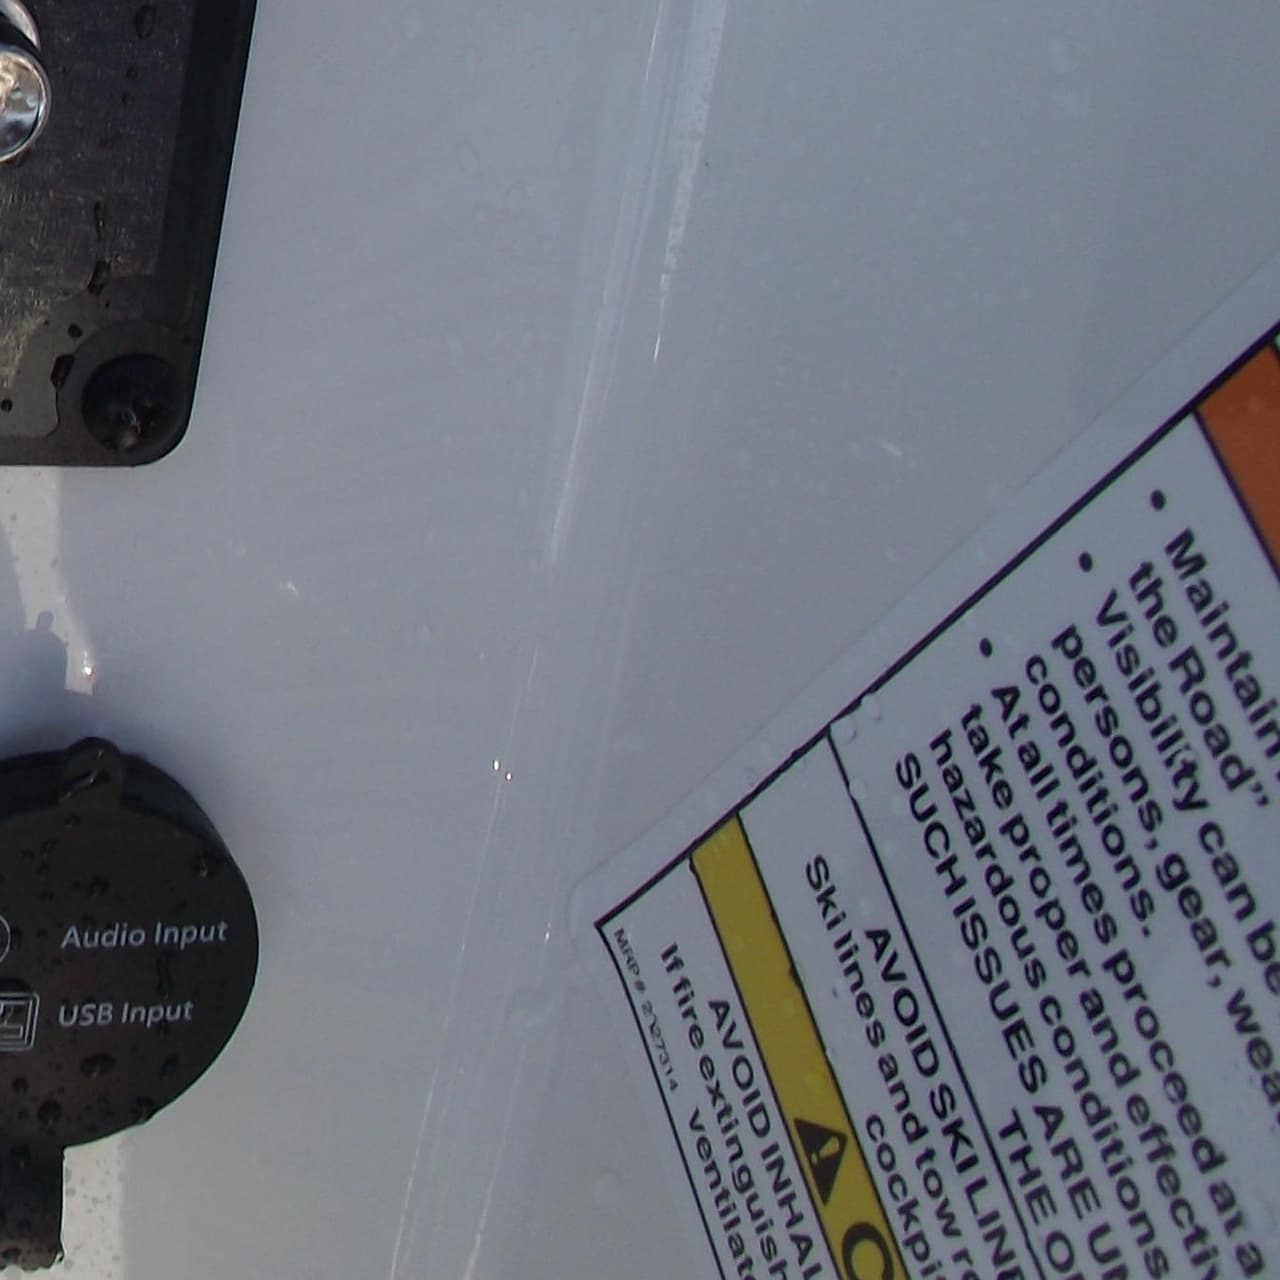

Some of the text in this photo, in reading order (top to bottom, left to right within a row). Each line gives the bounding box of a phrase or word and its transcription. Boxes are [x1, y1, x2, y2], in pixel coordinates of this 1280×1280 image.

[1129, 561, 1178, 648] the
[1025, 654, 1155, 937] conditions.
[1051, 624, 1280, 1125] persons, gear, wea
[1096, 587, 1209, 811] Visibility
[1198, 821, 1257, 922] can
[58, 999, 194, 1028] USB Input
[61, 920, 228, 951] Audio Input
[661, 942, 684, 974] If
[672, 976, 705, 1050] fire
[895, 752, 967, 897] SUCH
[952, 896, 1048, 1094] ISSUES
[1032, 1105, 1102, 1220] ARE
[929, 728, 1170, 1280] hazardous conditions
[960, 703, 1013, 809] take
[998, 813, 1090, 978] proper
[1079, 987, 1141, 1088] and
[991, 685, 1030, 740] At
[1017, 740, 1061, 800] all
[1046, 799, 1118, 946] times
[1101, 948, 1227, 1174] proceed
[708, 999, 771, 1138] AVOID
[805, 854, 847, 931] Ski
[833, 929, 886, 1049] lines
[877, 1052, 929, 1144] and
[915, 1146, 962, 1237] tow
[864, 927, 940, 1078] AVOID
[929, 1082, 979, 1175] SKI
[998, 1106, 1058, 1226] THE
[865, 1114, 946, 1280] cockpi
